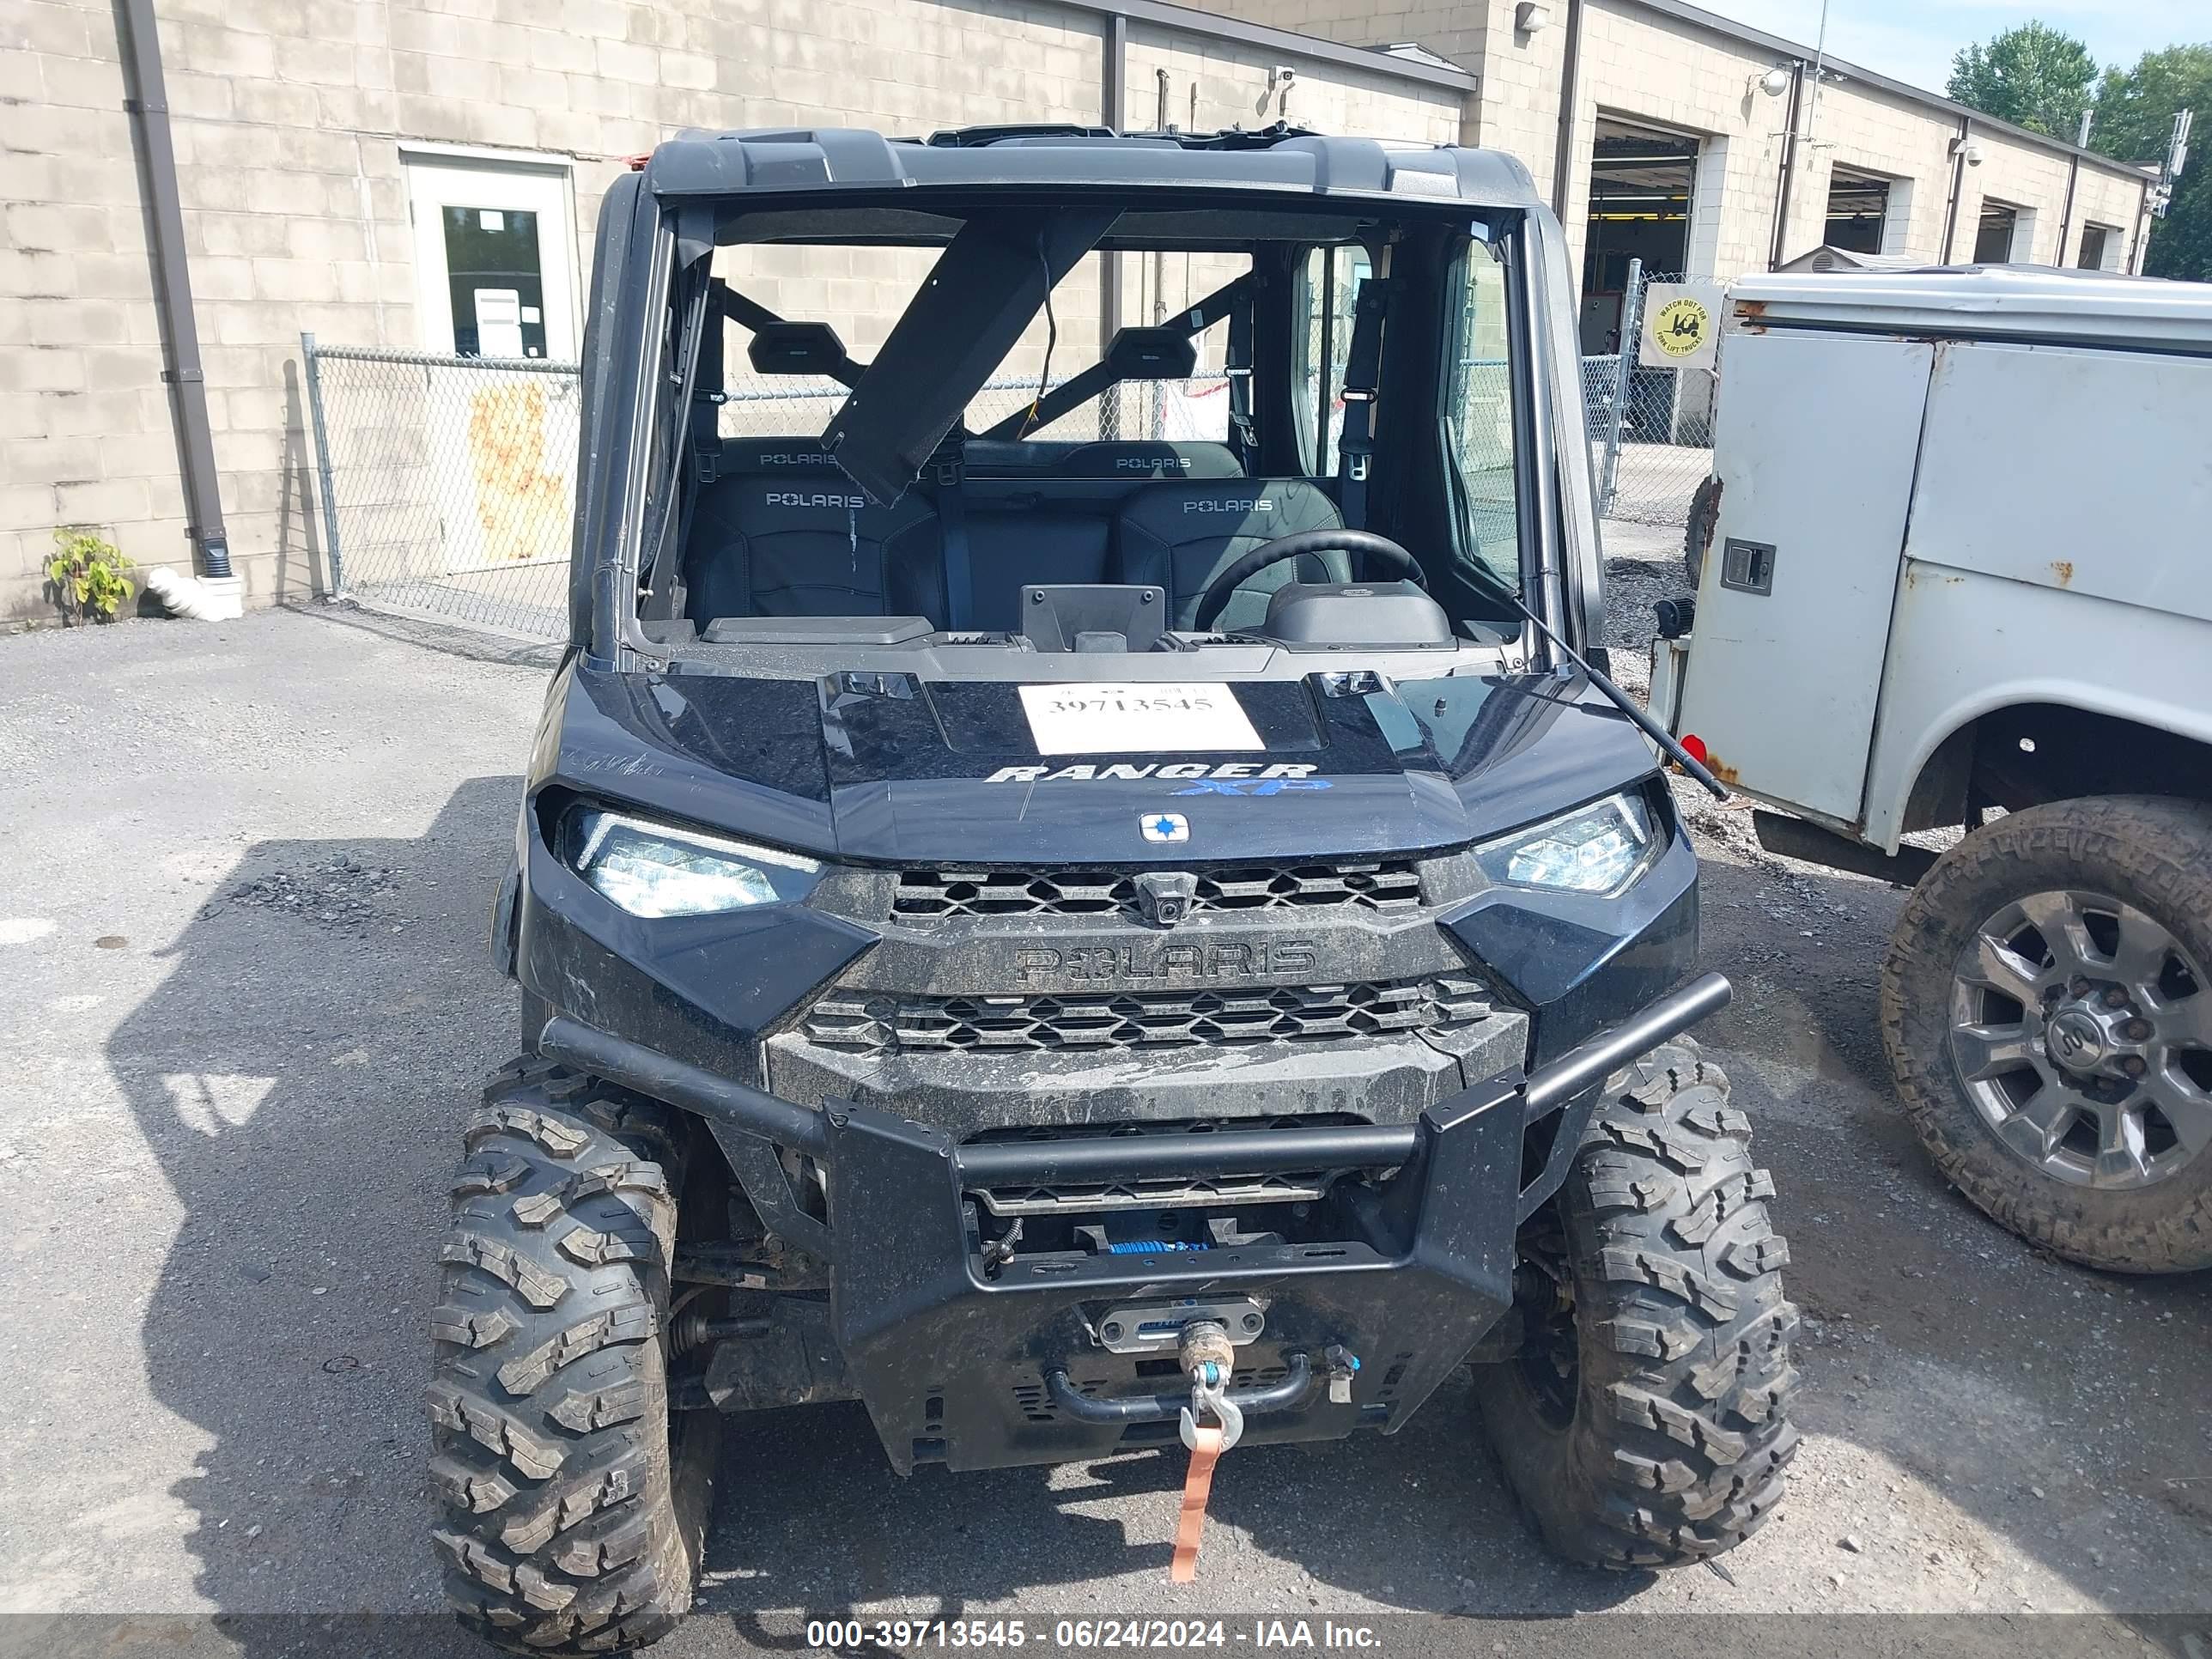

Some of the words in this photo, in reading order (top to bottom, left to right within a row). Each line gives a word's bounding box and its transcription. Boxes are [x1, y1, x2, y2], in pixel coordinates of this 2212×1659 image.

[1660, 301, 1682, 317] WATCH
[1684, 299, 1698, 308] OUT
[1696, 307, 1707, 320] FOR
[1656, 331, 1668, 348] FORK
[1667, 344, 1680, 353] LIFT
[1680, 336, 1703, 352] TRUCKS
[760, 453, 837, 465] POLARIS
[1115, 457, 1192, 469] POLARIS
[766, 493, 865, 509] POLARIS
[1183, 500, 1273, 514] POLARIS
[1048, 698, 1213, 714] 39713545
[983, 763, 1318, 783] RANGER
[1168, 779, 1334, 797] XP
[1016, 939, 1316, 983] POLARIS
